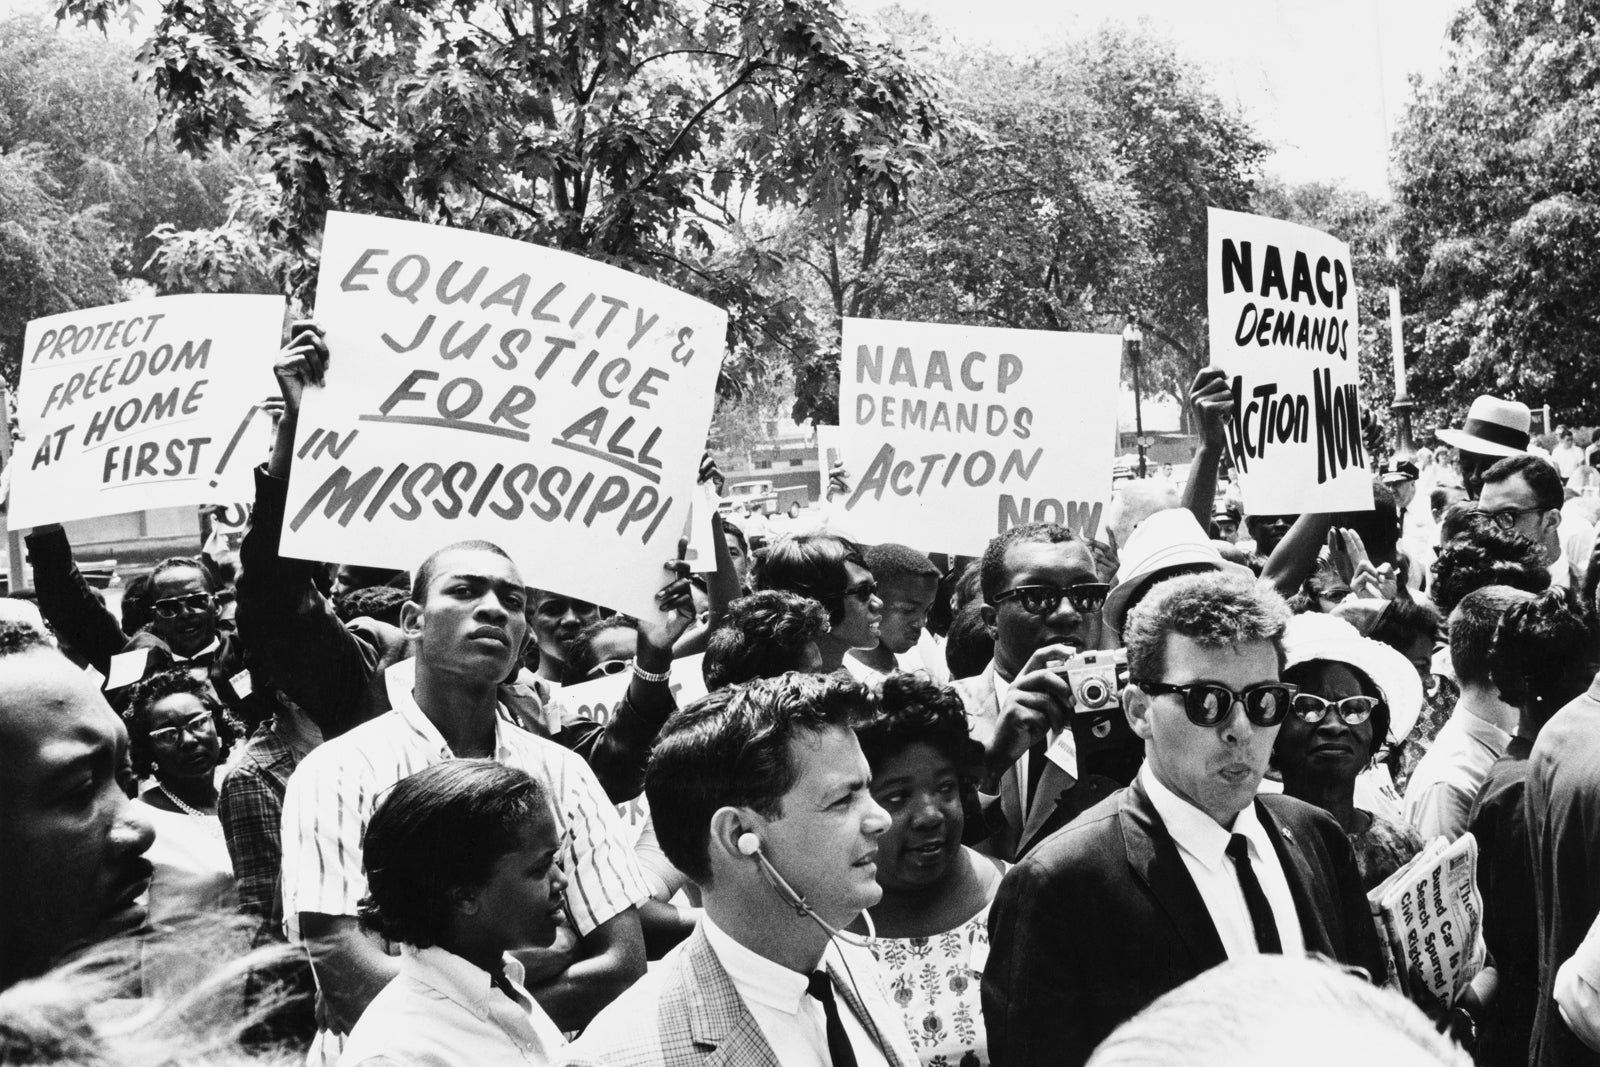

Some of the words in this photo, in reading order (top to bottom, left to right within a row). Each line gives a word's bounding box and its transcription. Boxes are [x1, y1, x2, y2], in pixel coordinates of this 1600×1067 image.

[339, 248, 660, 350] EQUALITY
[670, 326, 696, 367] &
[1221, 238, 1348, 310] NAACP
[31, 313, 165, 363] PROTECT
[380, 313, 670, 410] JUSTICE
[1234, 302, 1349, 361] DEMANDS
[40, 338, 212, 418] FREEDOM
[856, 344, 1024, 394] NAACP
[31, 424, 75, 470] AT
[83, 379, 208, 446] HOME
[296, 427, 359, 460] IN
[378, 369, 537, 430] FOR
[560, 406, 664, 470] ALL
[855, 393, 1033, 440] DEMANDS
[289, 460, 673, 545] MISSISSIPPI
[844, 442, 1044, 511] ACTION
[997, 493, 1103, 540] NOW
[1401, 891, 1414, 927] Civil
[1431, 865, 1448, 918] Burned
[1440, 920, 1455, 948] Car
[1448, 951, 1461, 969] Is
[1459, 877, 1473, 914] The
[1416, 879, 1431, 930] Search
[1424, 931, 1447, 990] Spurred
